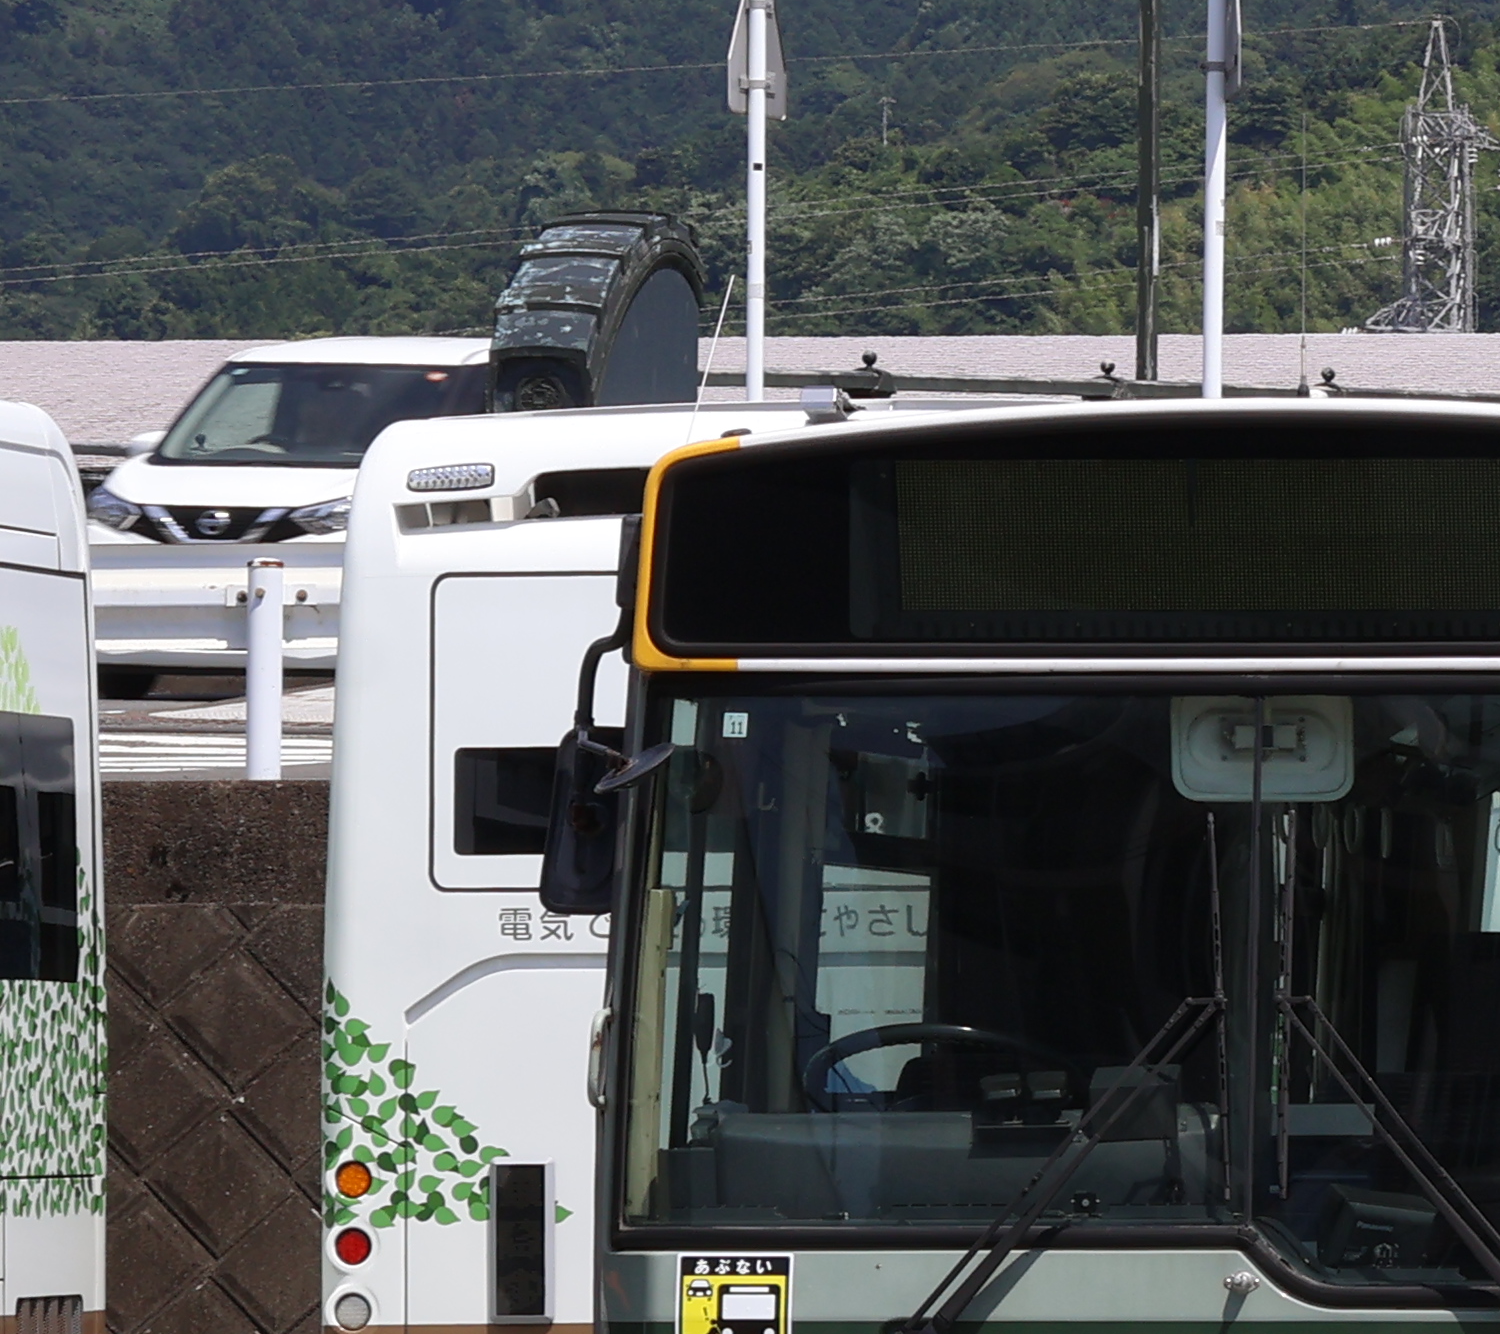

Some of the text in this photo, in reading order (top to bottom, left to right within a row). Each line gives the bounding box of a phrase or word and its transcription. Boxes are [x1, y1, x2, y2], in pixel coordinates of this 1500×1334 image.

[730, 721, 744, 735] 11
[694, 1259, 772, 1274] あぶない
